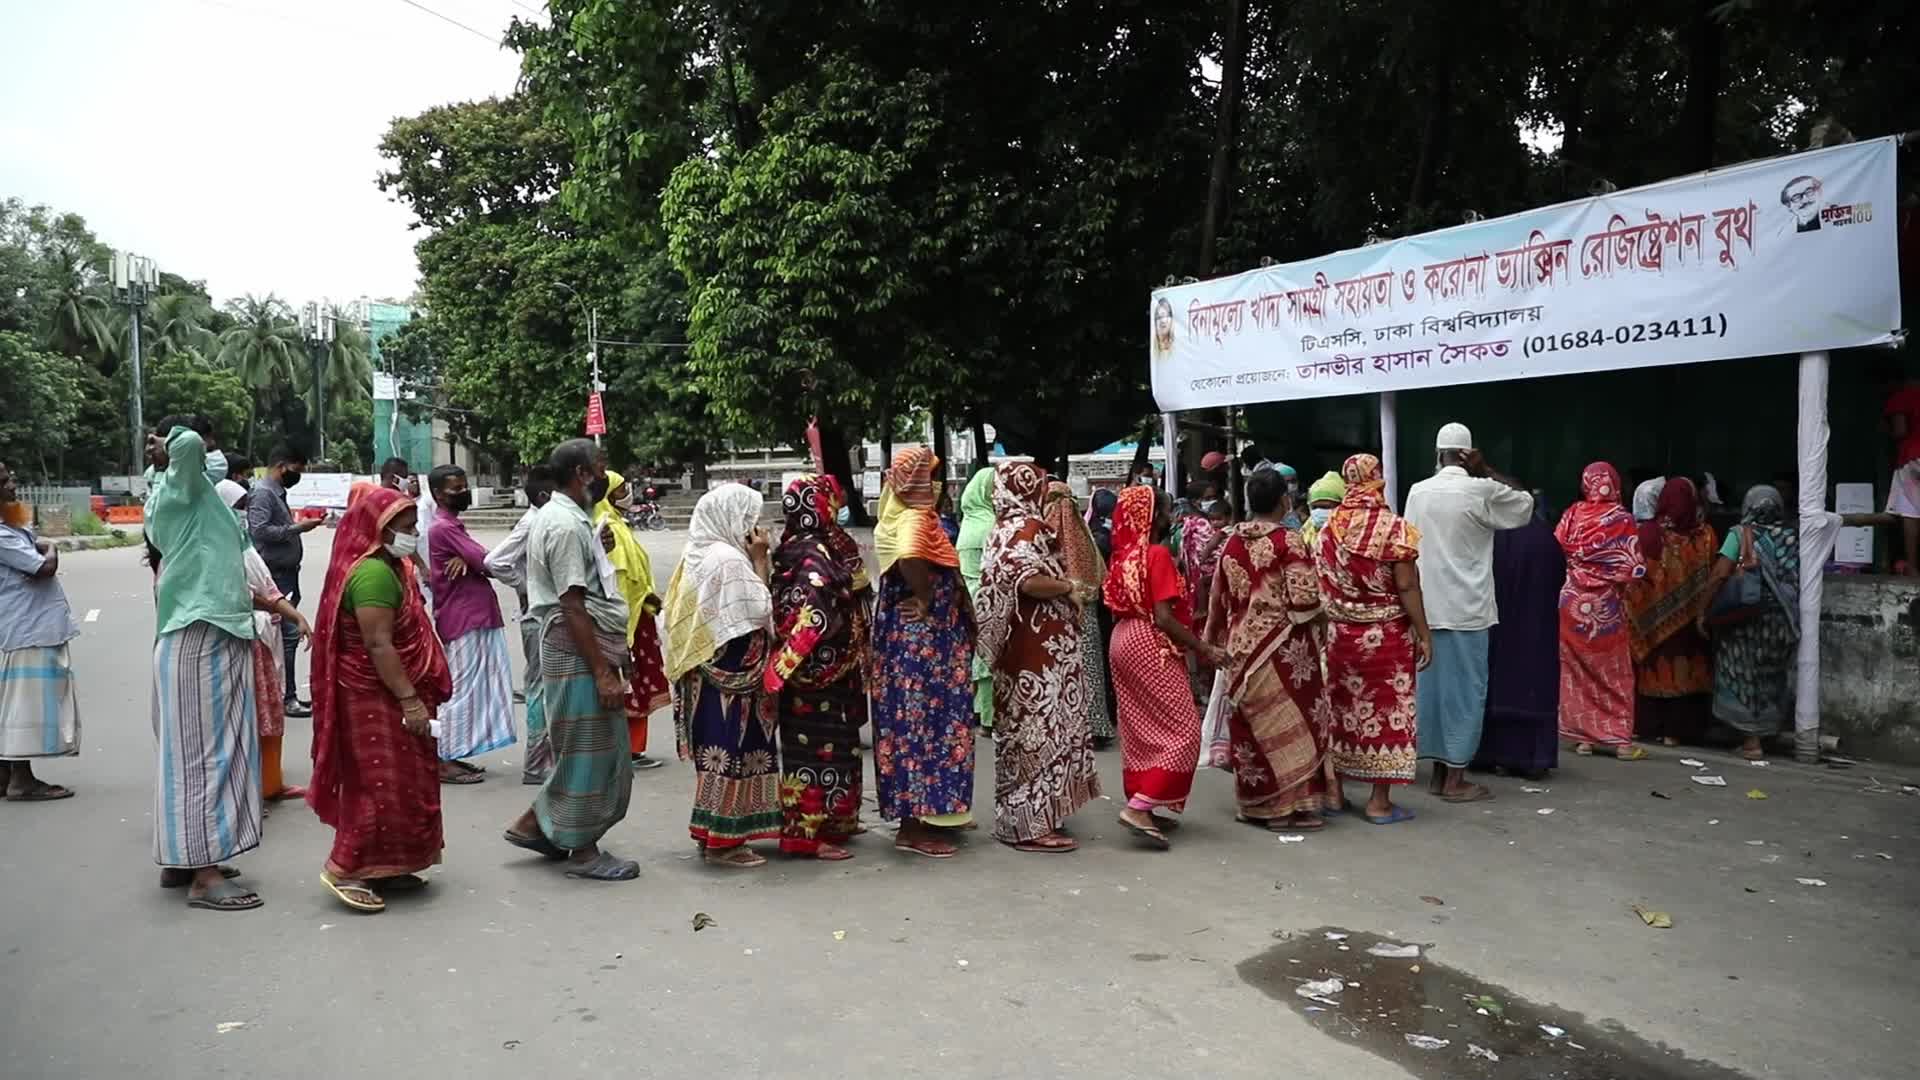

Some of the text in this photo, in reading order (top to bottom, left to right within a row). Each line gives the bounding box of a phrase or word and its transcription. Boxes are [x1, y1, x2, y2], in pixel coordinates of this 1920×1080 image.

[1188, 298, 1246, 344] বিনামূল্যে
[1286, 271, 1329, 323] সামগ্রী
[1335, 268, 1394, 317] সহায়তা
[1402, 268, 1416, 301] ও
[1424, 252, 1489, 298] করোনা
[1495, 230, 1573, 289] ভ্যাক্সিন
[1712, 198, 1757, 267] বুথ
[1296, 353, 1365, 381] তানভীর
[1371, 348, 1432, 373] হাসান
[1439, 339, 1512, 364] সৈকত
[1523, 312, 1728, 358] (01684-023411)
[1302, 305, 1544, 352] টিএসসি, ঢাকা বিশ্ববিদ্যালয়
